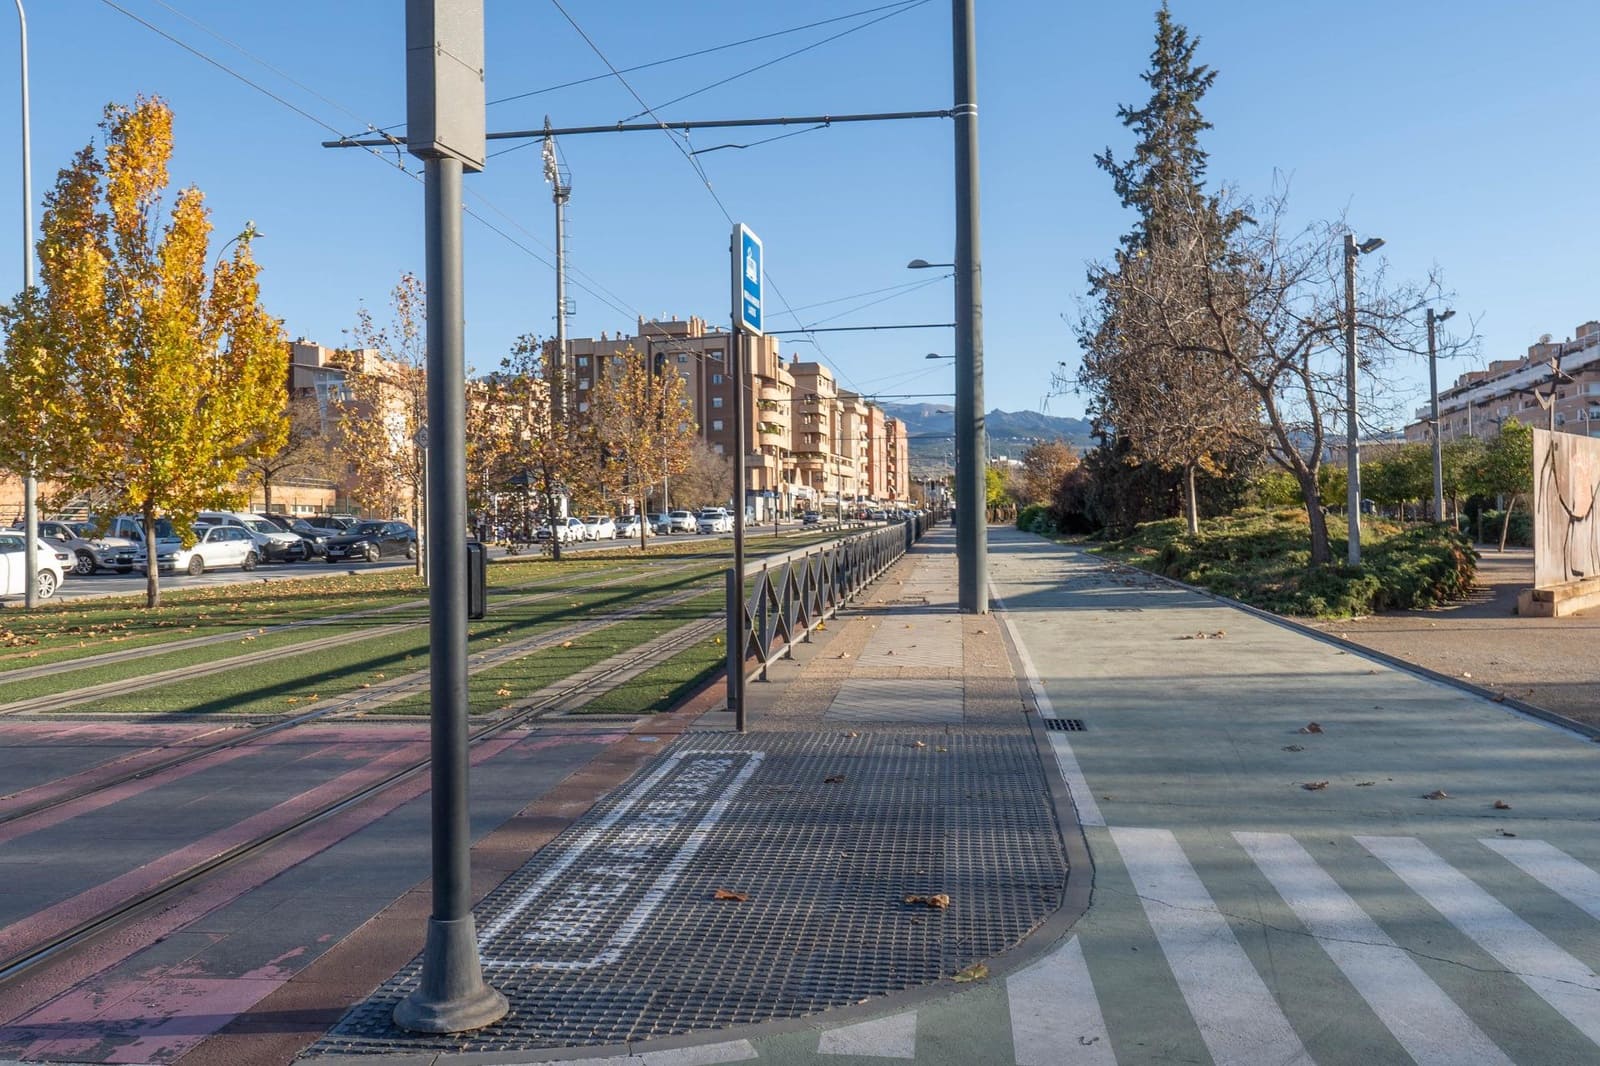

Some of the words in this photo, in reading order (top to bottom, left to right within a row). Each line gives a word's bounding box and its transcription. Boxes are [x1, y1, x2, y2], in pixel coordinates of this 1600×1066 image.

[520, 881, 629, 942] MIRE
[583, 862, 645, 877] A
[661, 759, 735, 796] LADOS
